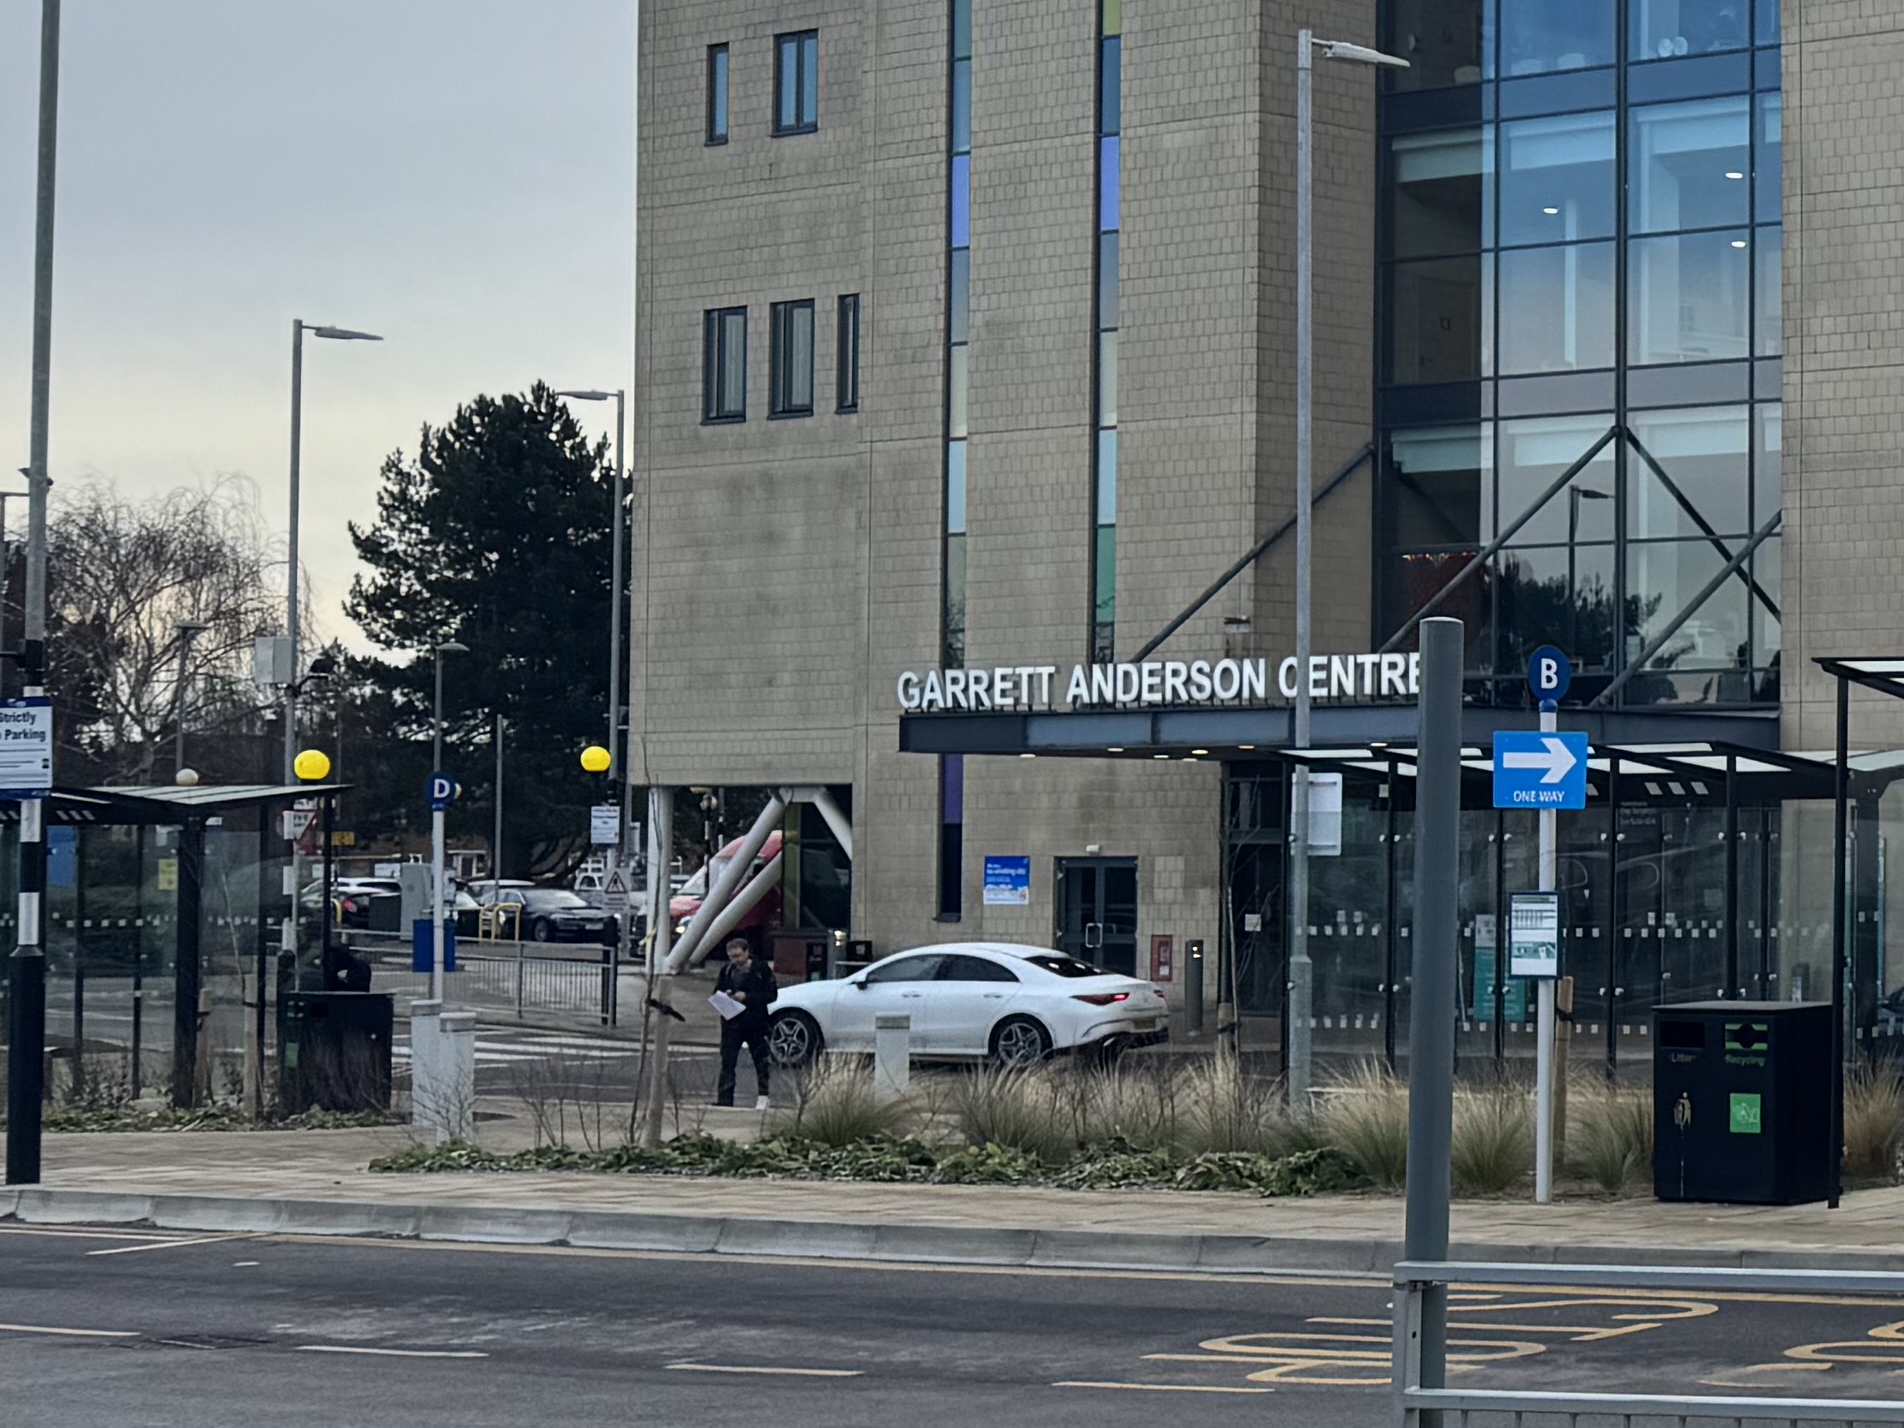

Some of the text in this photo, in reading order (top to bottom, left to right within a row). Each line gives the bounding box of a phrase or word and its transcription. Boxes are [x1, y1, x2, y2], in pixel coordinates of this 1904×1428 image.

[1541, 658, 1558, 689] B
[897, 666, 1056, 710] GARRETT
[1066, 658, 1266, 705] ANDERSON
[5, 729, 46, 742] Parking
[434, 778, 450, 798] D
[1513, 791, 1565, 803] ONE WAY
